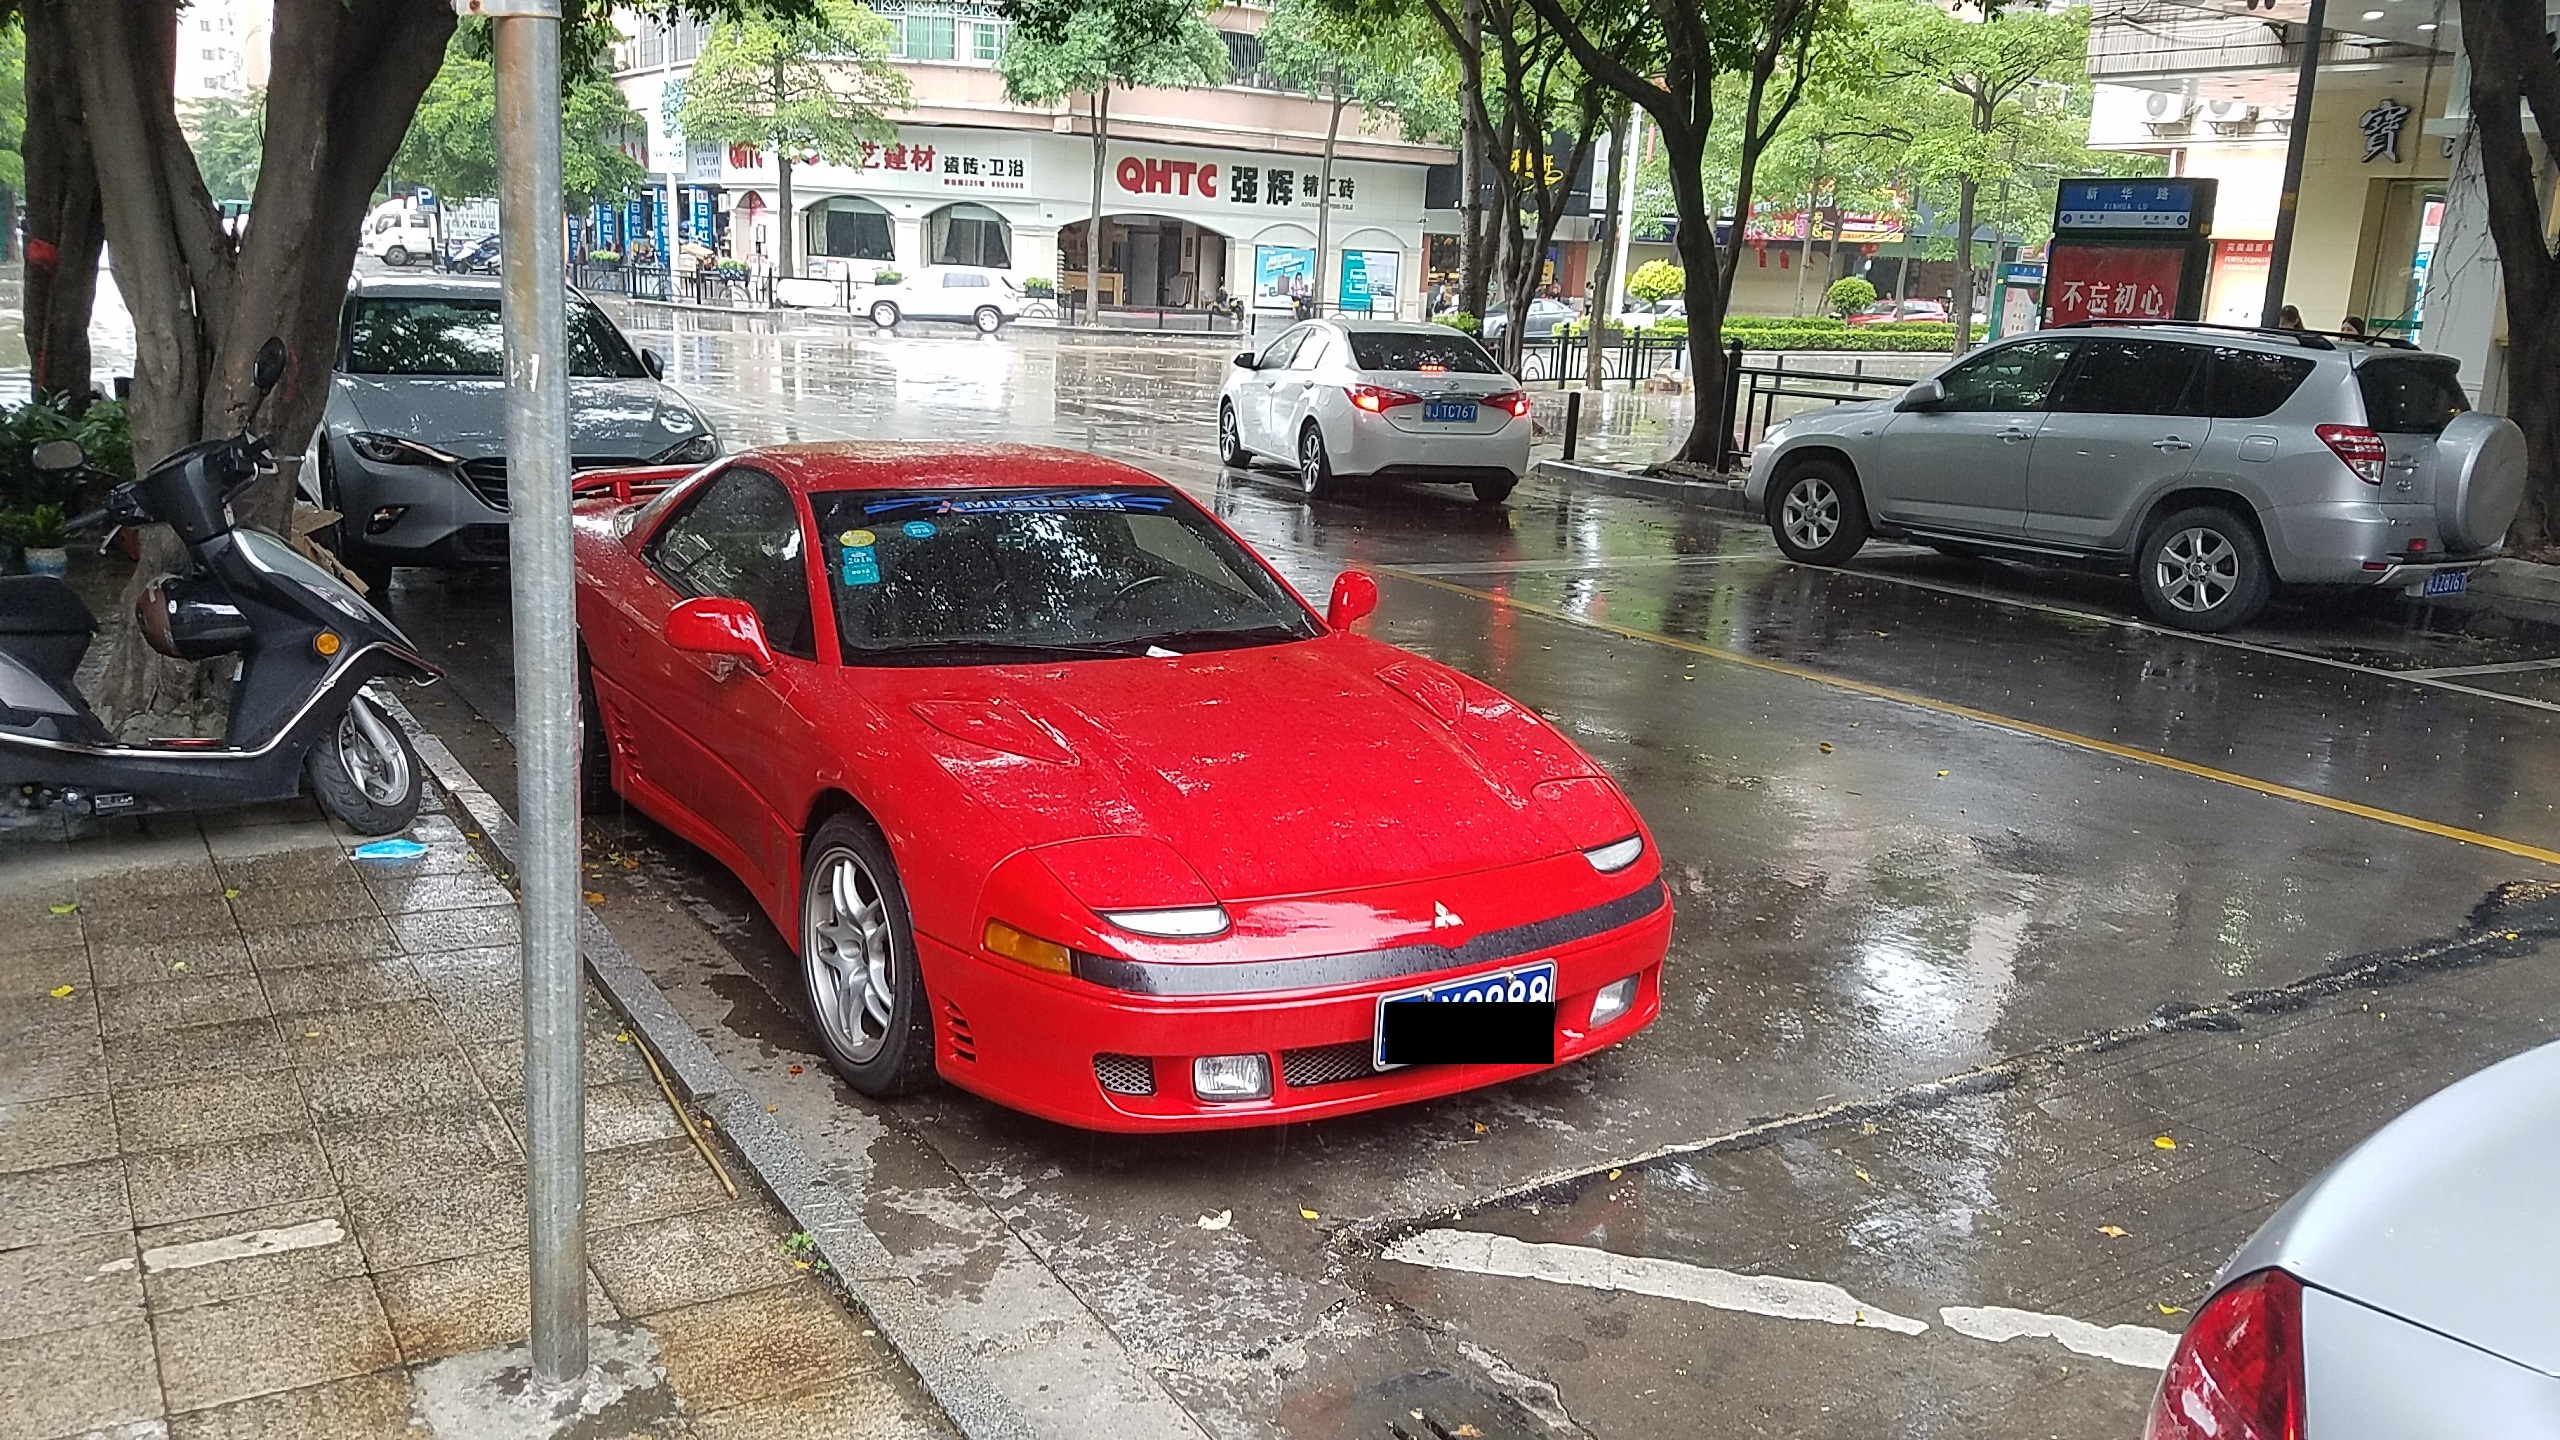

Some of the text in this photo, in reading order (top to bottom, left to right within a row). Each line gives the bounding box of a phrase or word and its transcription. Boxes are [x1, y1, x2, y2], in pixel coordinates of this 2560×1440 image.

[1116, 157, 1218, 198] QHTC
[1230, 165, 1295, 206] 强辉
[2086, 187, 2170, 200] 新华路
[417, 187, 432, 204] P
[2061, 280, 2164, 315] 不忘初心
